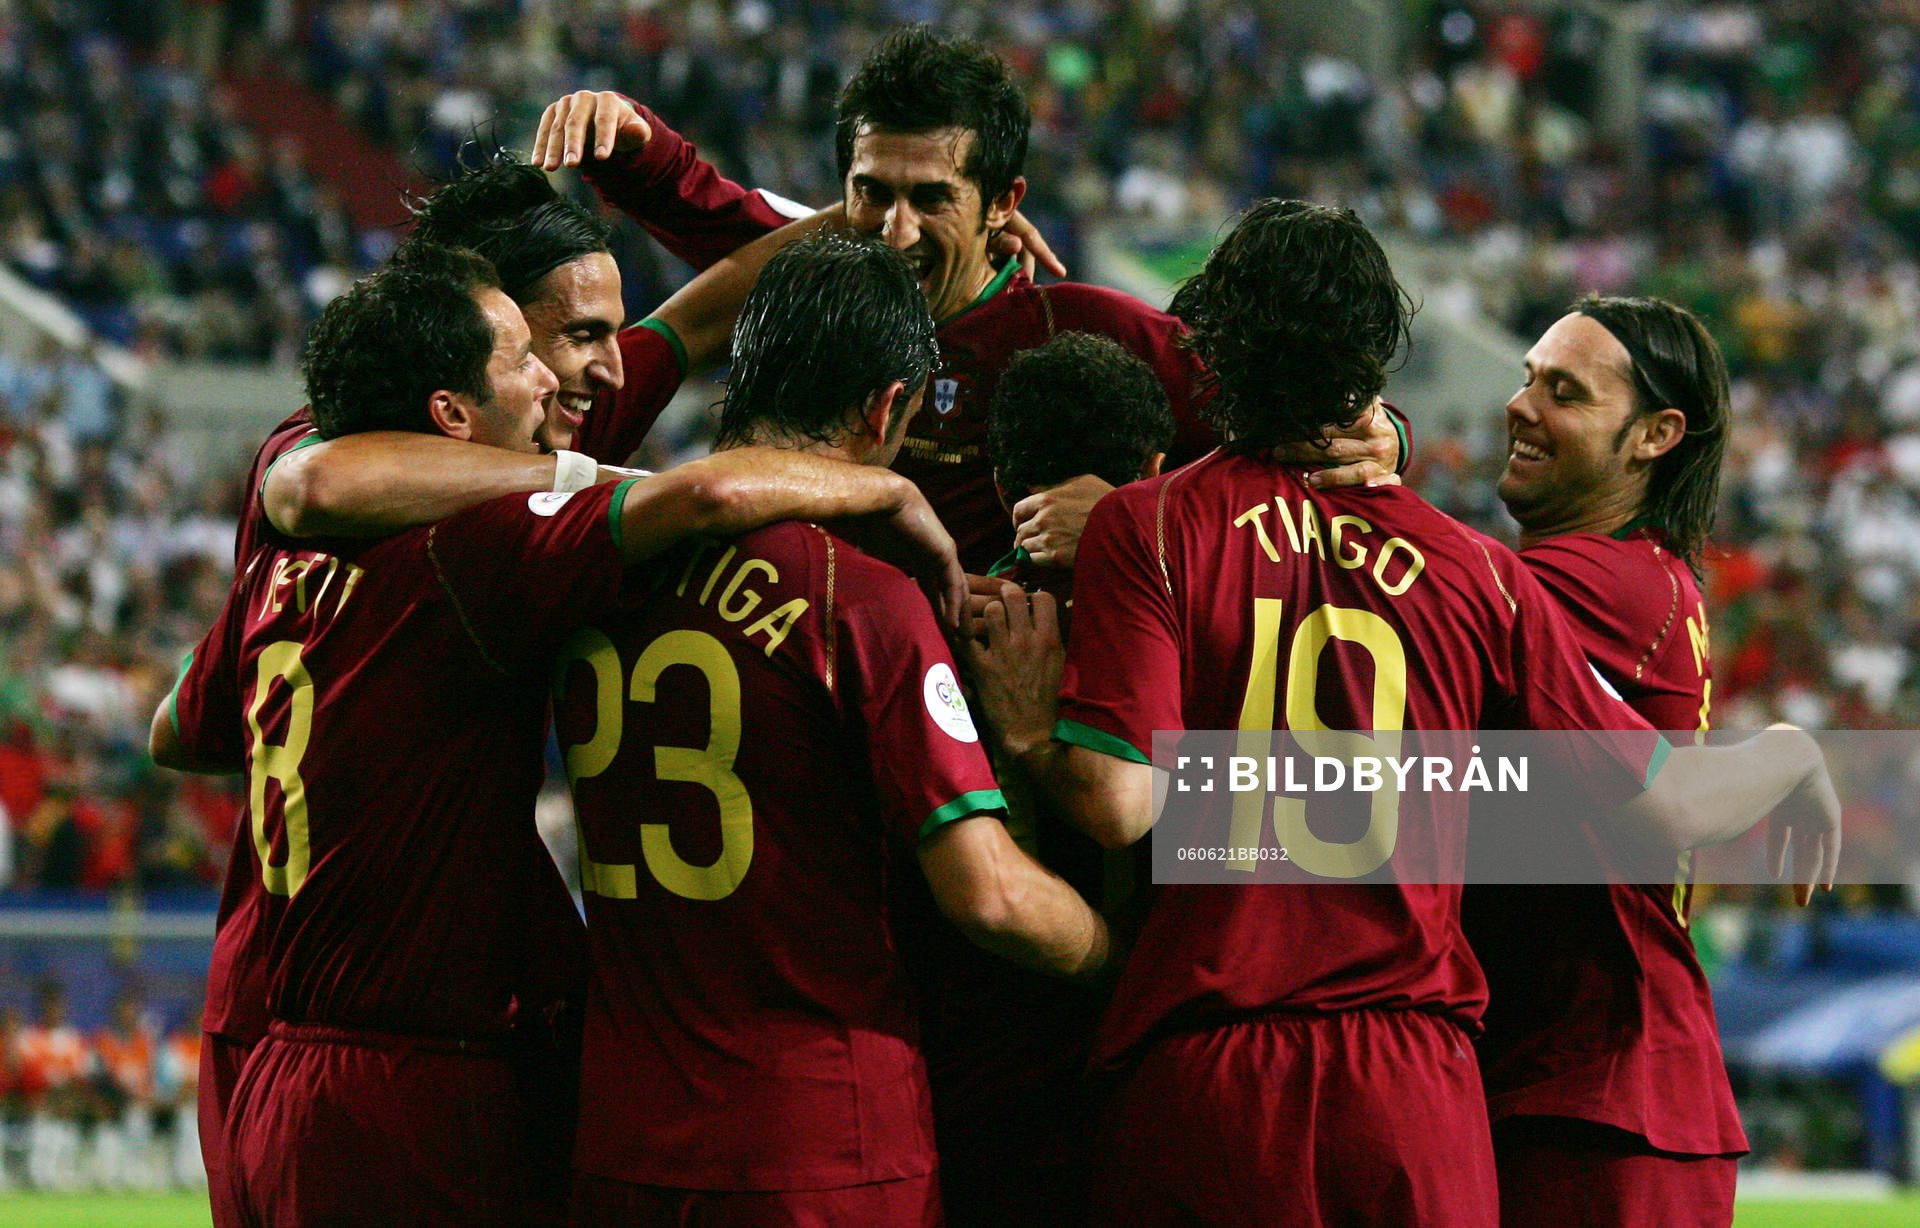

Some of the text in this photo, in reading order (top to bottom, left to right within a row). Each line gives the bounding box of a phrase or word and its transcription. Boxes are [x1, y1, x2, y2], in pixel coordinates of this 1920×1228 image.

[675, 541, 811, 659] TIGA
[1233, 495, 1426, 596] TIAGO
[247, 640, 315, 899] 8
[553, 627, 754, 901] 23
[1224, 597, 1407, 879] 19
